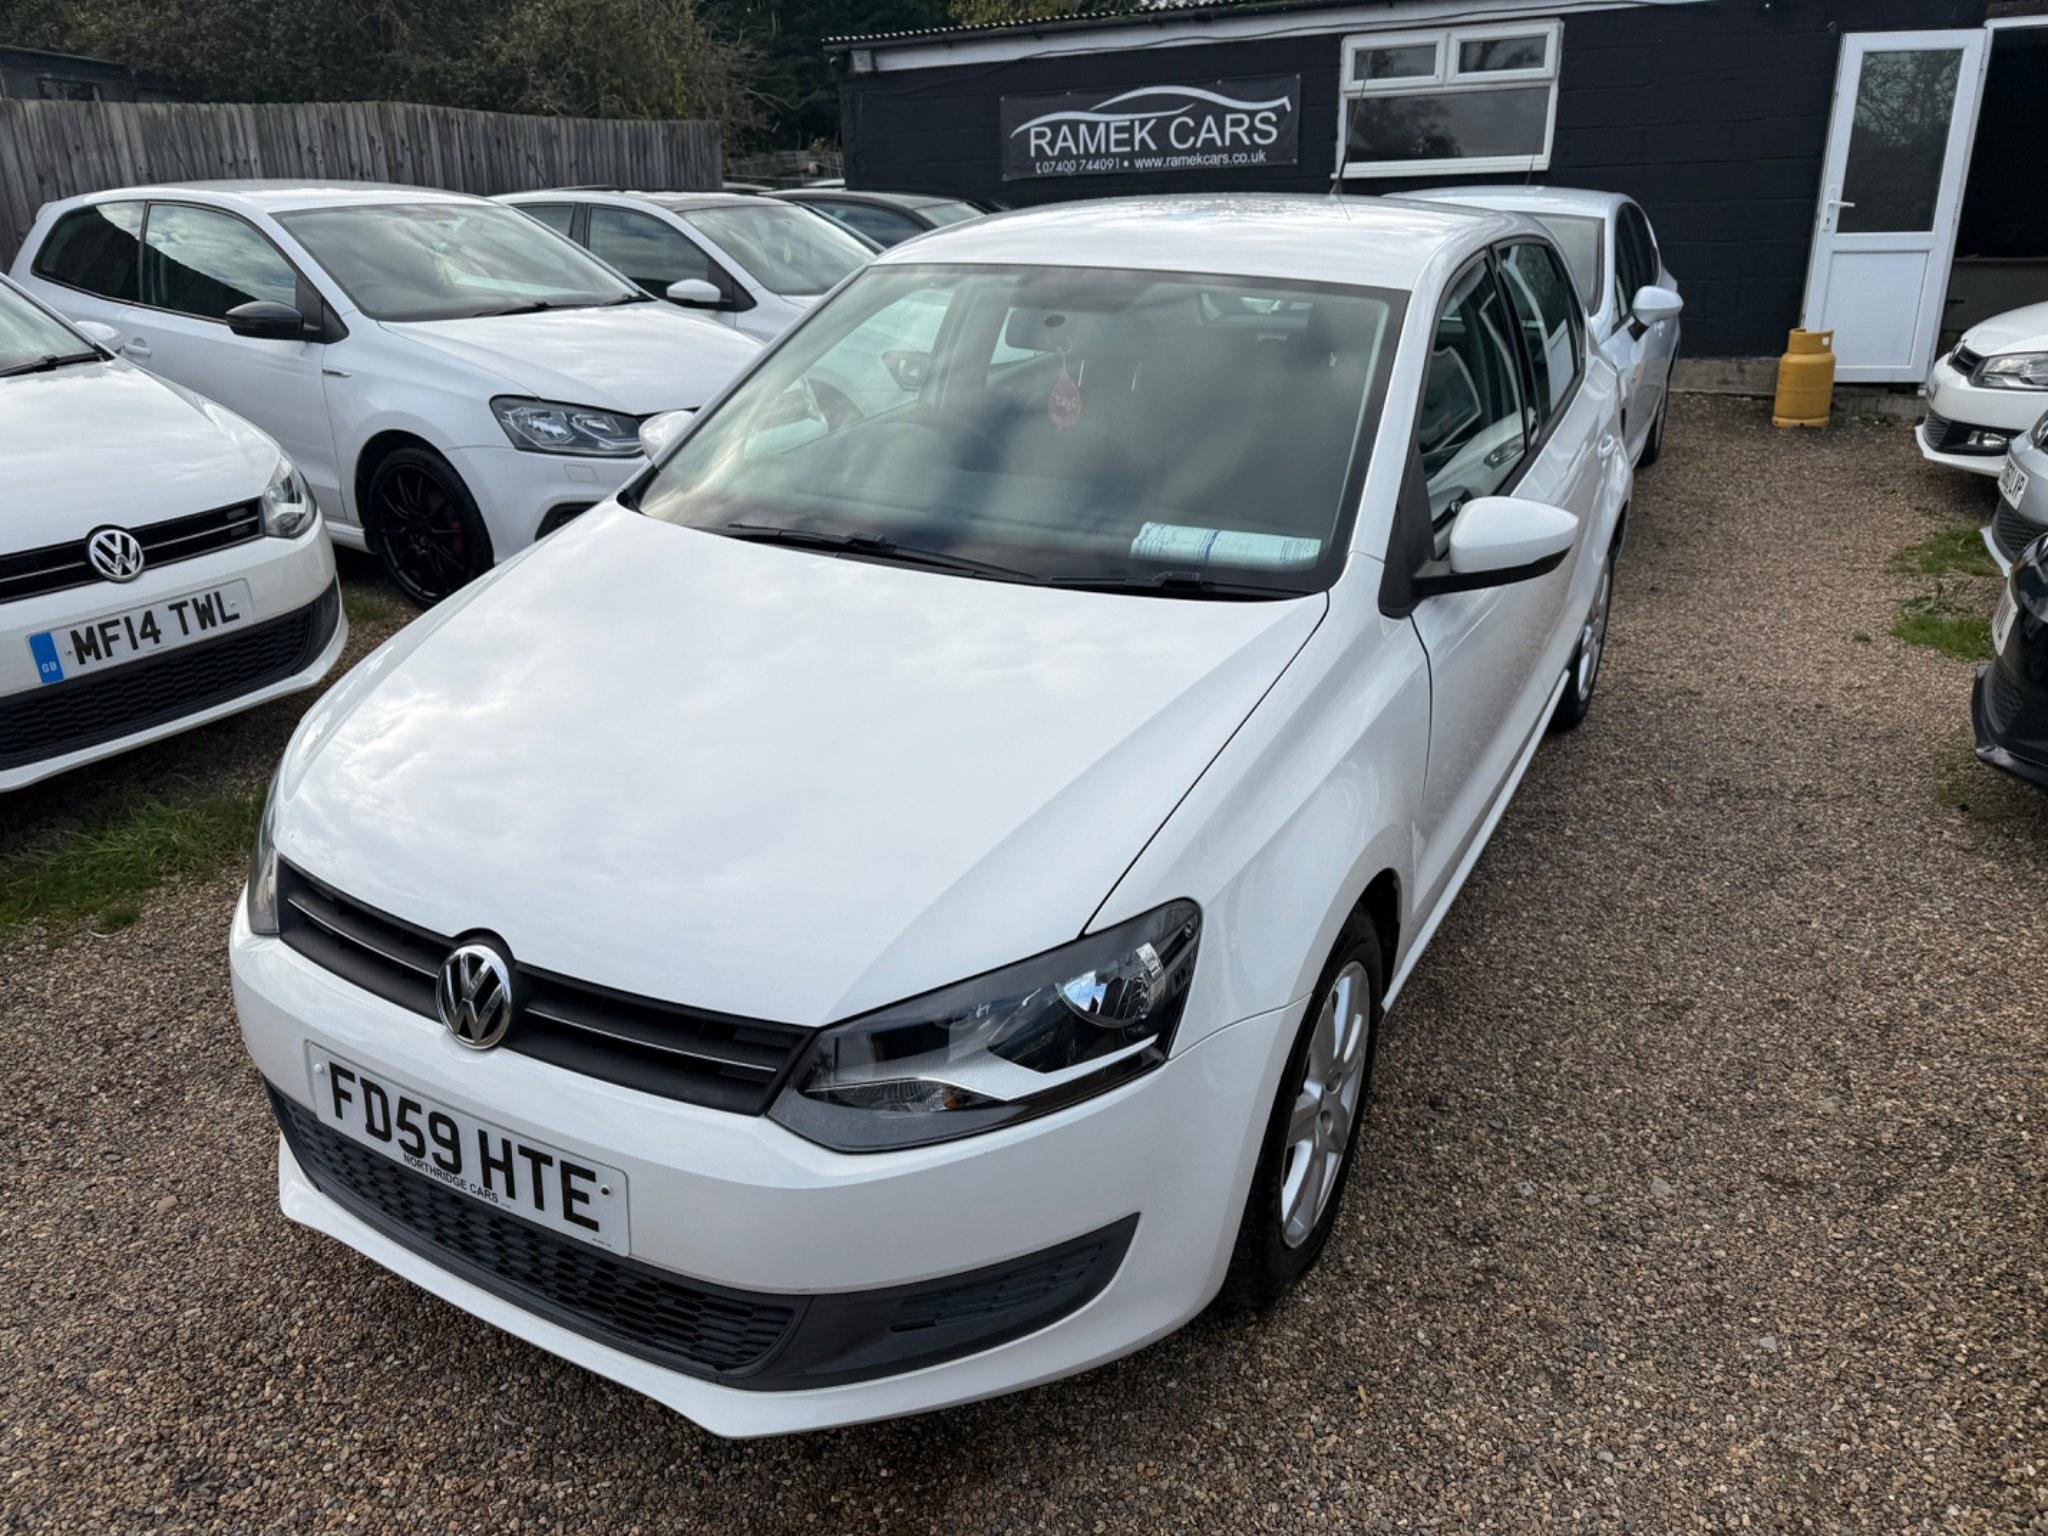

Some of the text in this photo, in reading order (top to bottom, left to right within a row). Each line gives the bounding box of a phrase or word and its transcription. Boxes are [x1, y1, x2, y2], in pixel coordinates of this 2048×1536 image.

[1030, 111, 1278, 157] RAMEK CARS
[1042, 150, 1266, 173] 07400 744091 www.ramekcars.co.uk
[70, 591, 240, 665] MF14 TWL
[329, 1061, 600, 1233] FD59 HTE
[403, 1151, 499, 1204] NORTHRIDGE CARS
